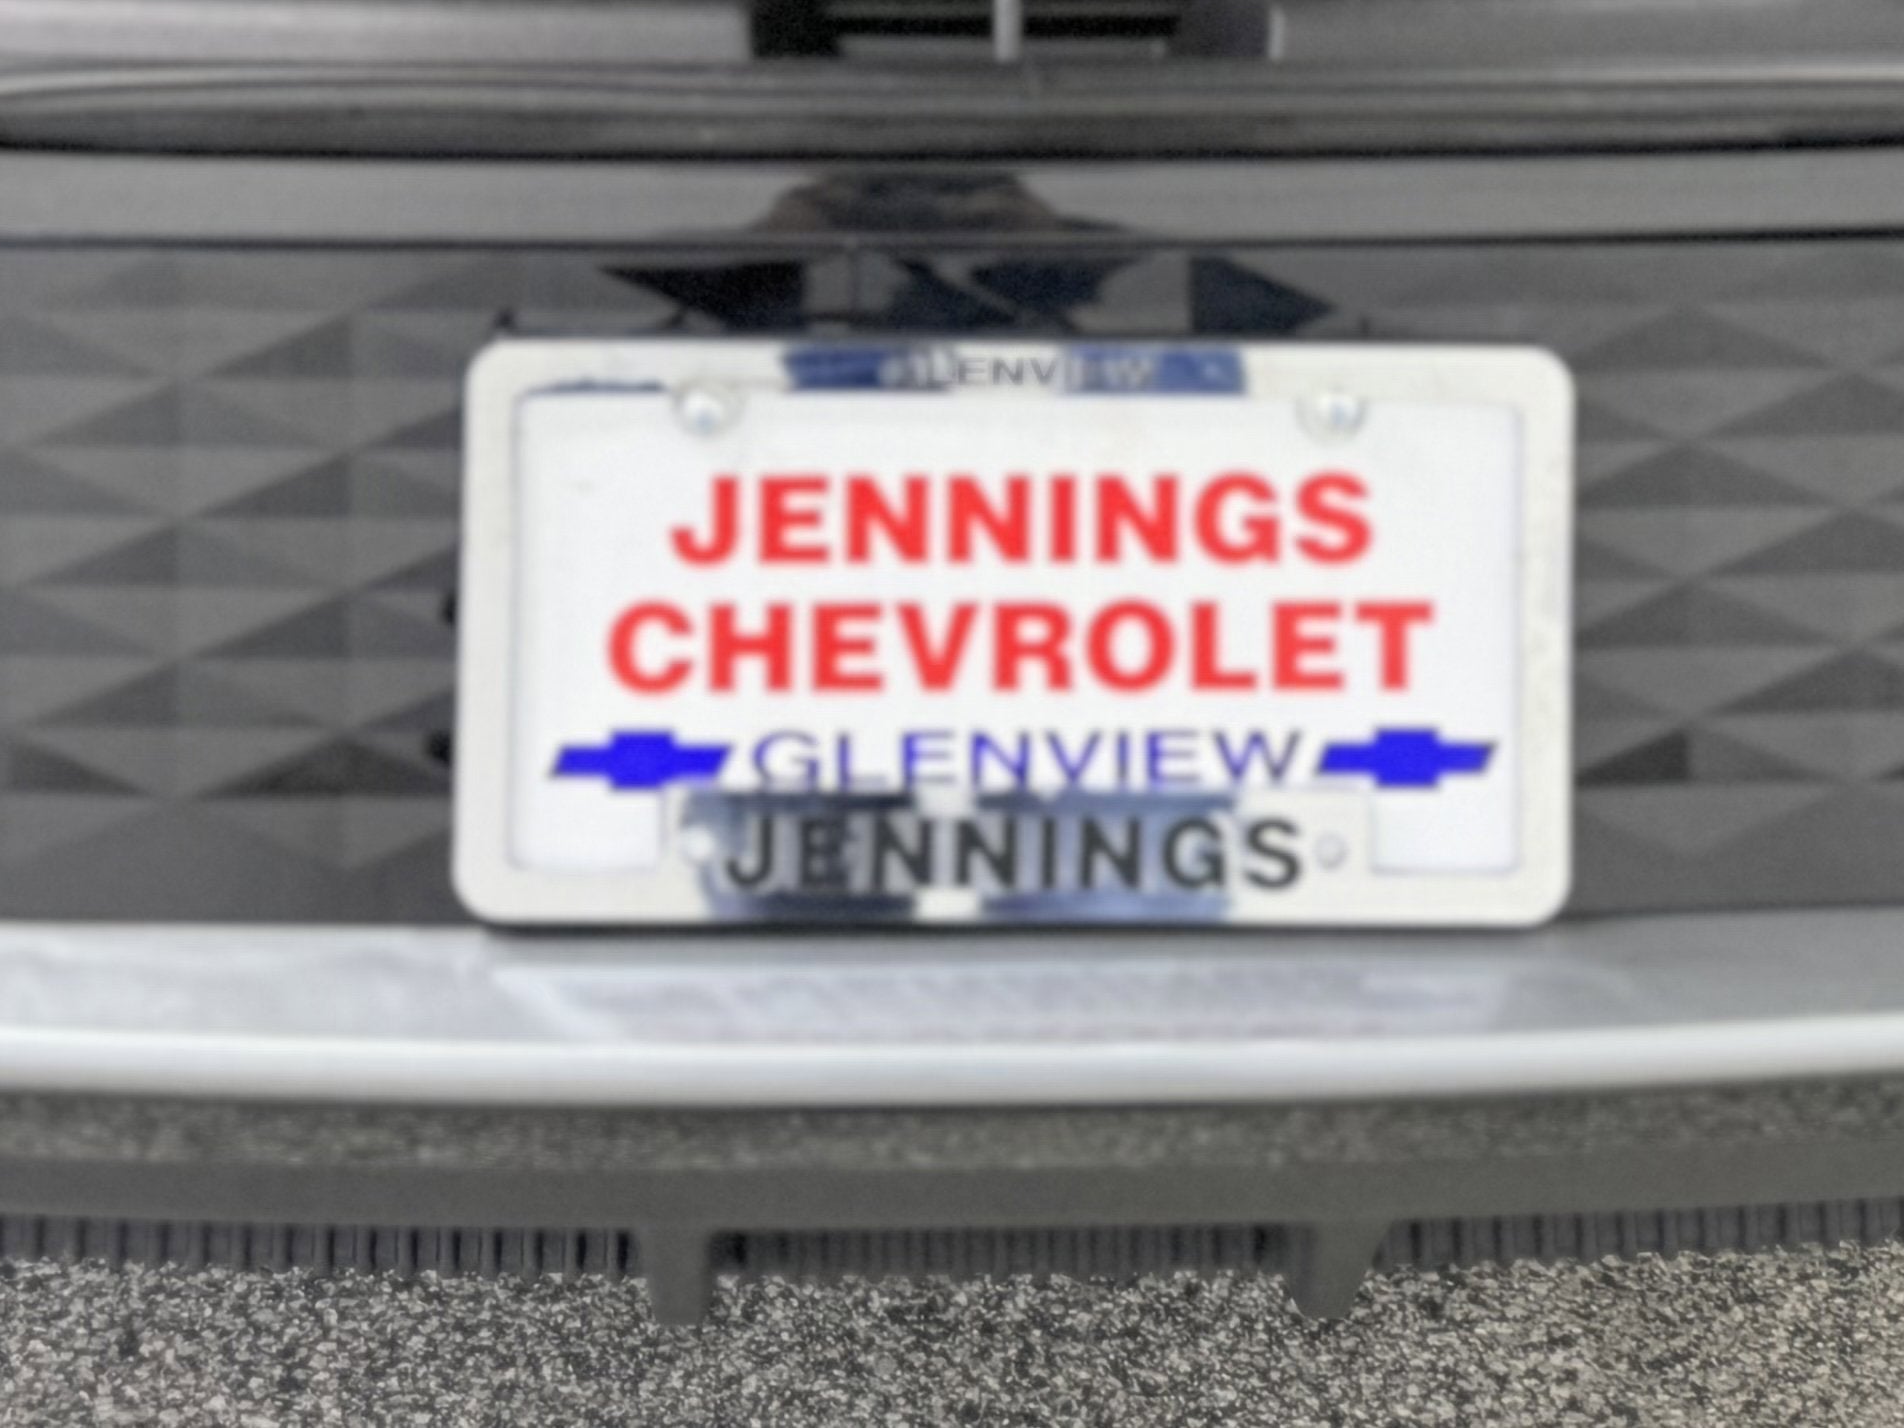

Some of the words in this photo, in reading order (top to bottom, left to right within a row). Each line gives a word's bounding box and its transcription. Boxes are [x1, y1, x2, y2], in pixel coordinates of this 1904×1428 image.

[670, 472, 1375, 565] JENNINGS
[605, 600, 1435, 695] CHEVROLET
[751, 728, 1304, 792] GLENVIEW
[725, 815, 1305, 890] JENNINGS
